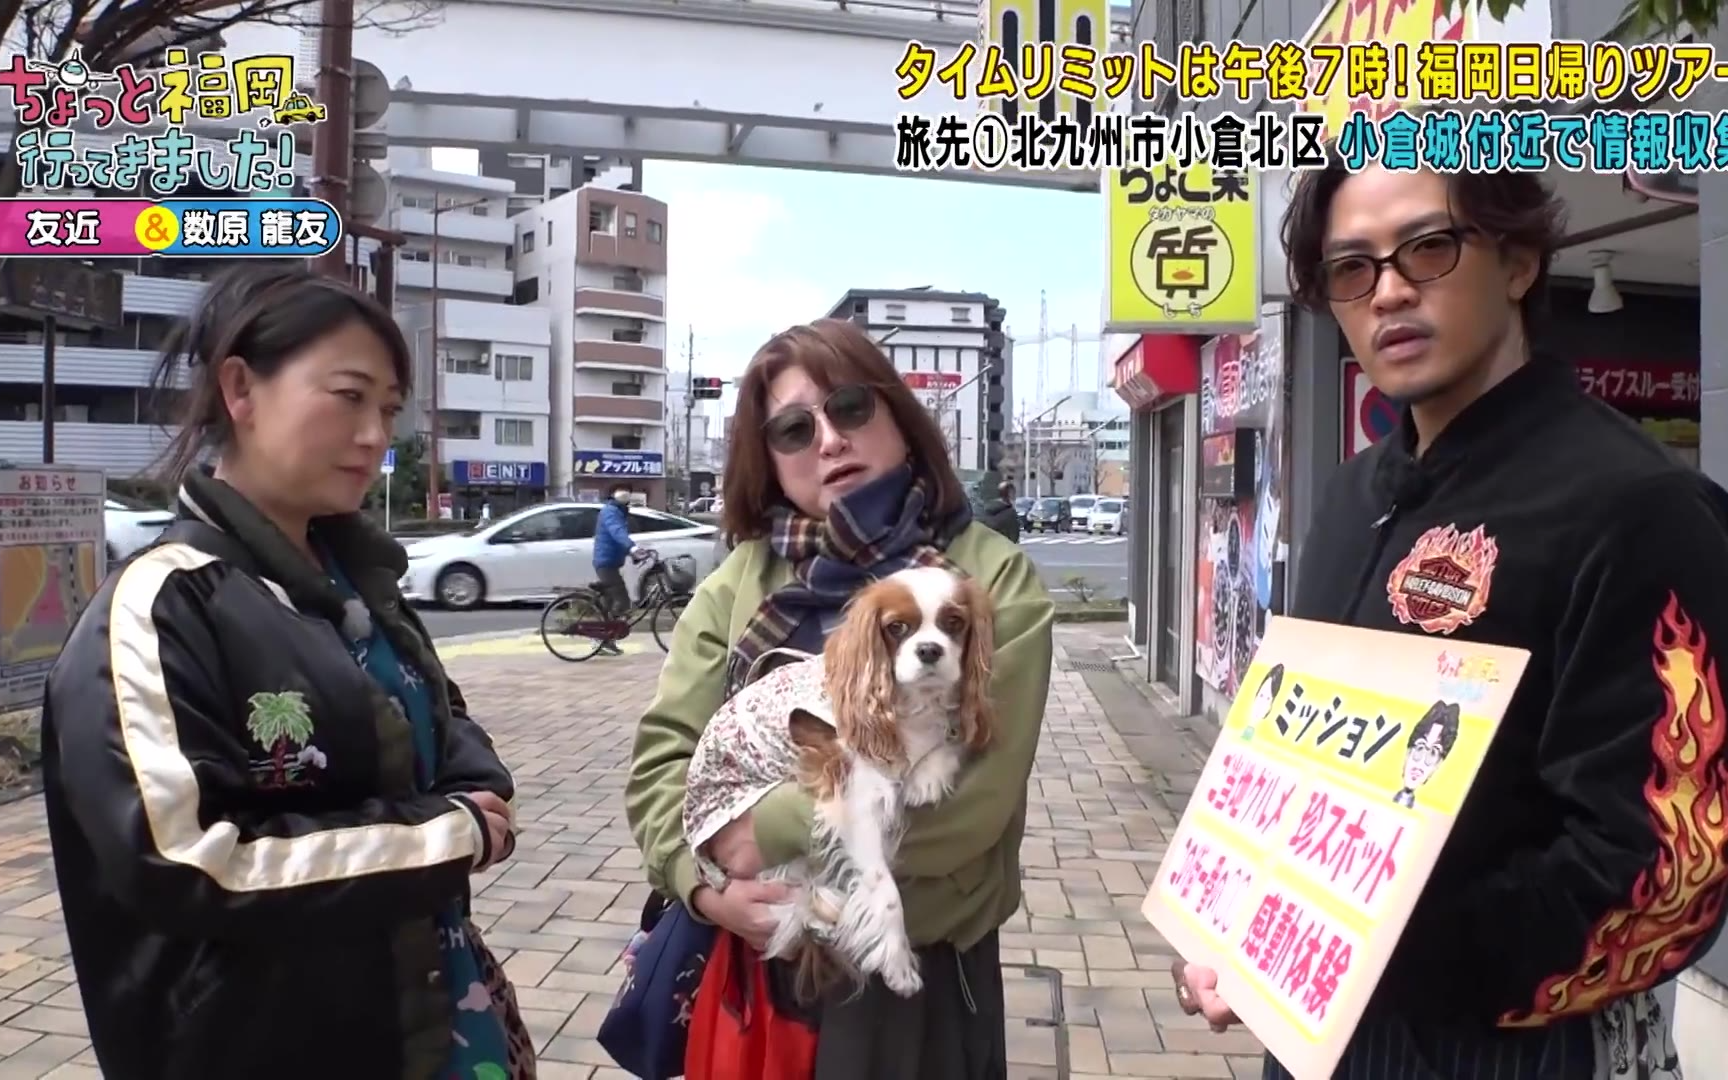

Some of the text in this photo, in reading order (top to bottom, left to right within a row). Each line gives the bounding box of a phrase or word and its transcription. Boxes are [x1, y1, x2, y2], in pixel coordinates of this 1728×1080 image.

[1576, 366, 1700, 401] ライブスルー受付
[19, 474, 77, 492] お知らせ
[470, 463, 530, 479] RENT
[1274, 683, 1401, 763] ミッション
[1207, 754, 1297, 834] ご当地グルメ
[1288, 791, 1405, 903] 珍スポット
[1241, 892, 1354, 1022] 感動体験
